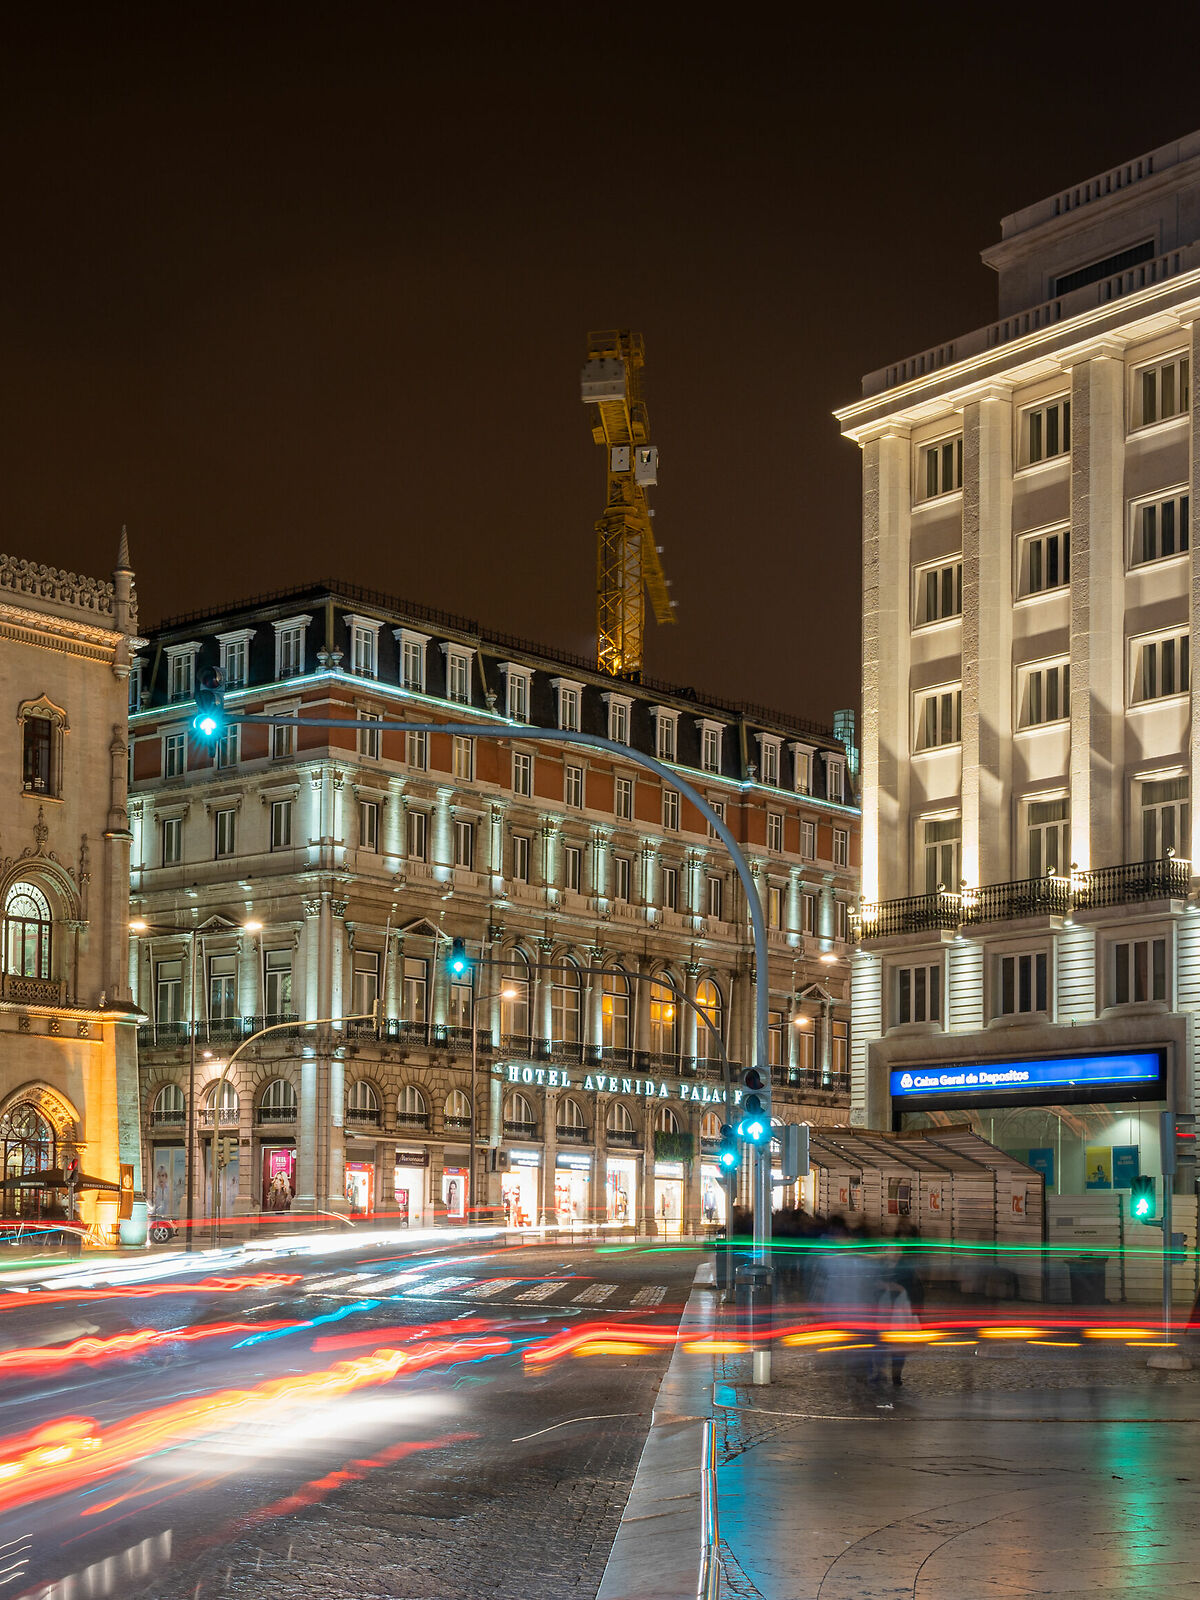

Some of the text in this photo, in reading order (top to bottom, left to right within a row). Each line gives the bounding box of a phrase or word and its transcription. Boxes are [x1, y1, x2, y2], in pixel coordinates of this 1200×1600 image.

[508, 1065, 571, 1087] HOTEL
[584, 1074, 669, 1098] AVENIDA
[914, 1075, 940, 1088] Caixa
[940, 1073, 965, 1086] Geral
[966, 1072, 978, 1084] de
